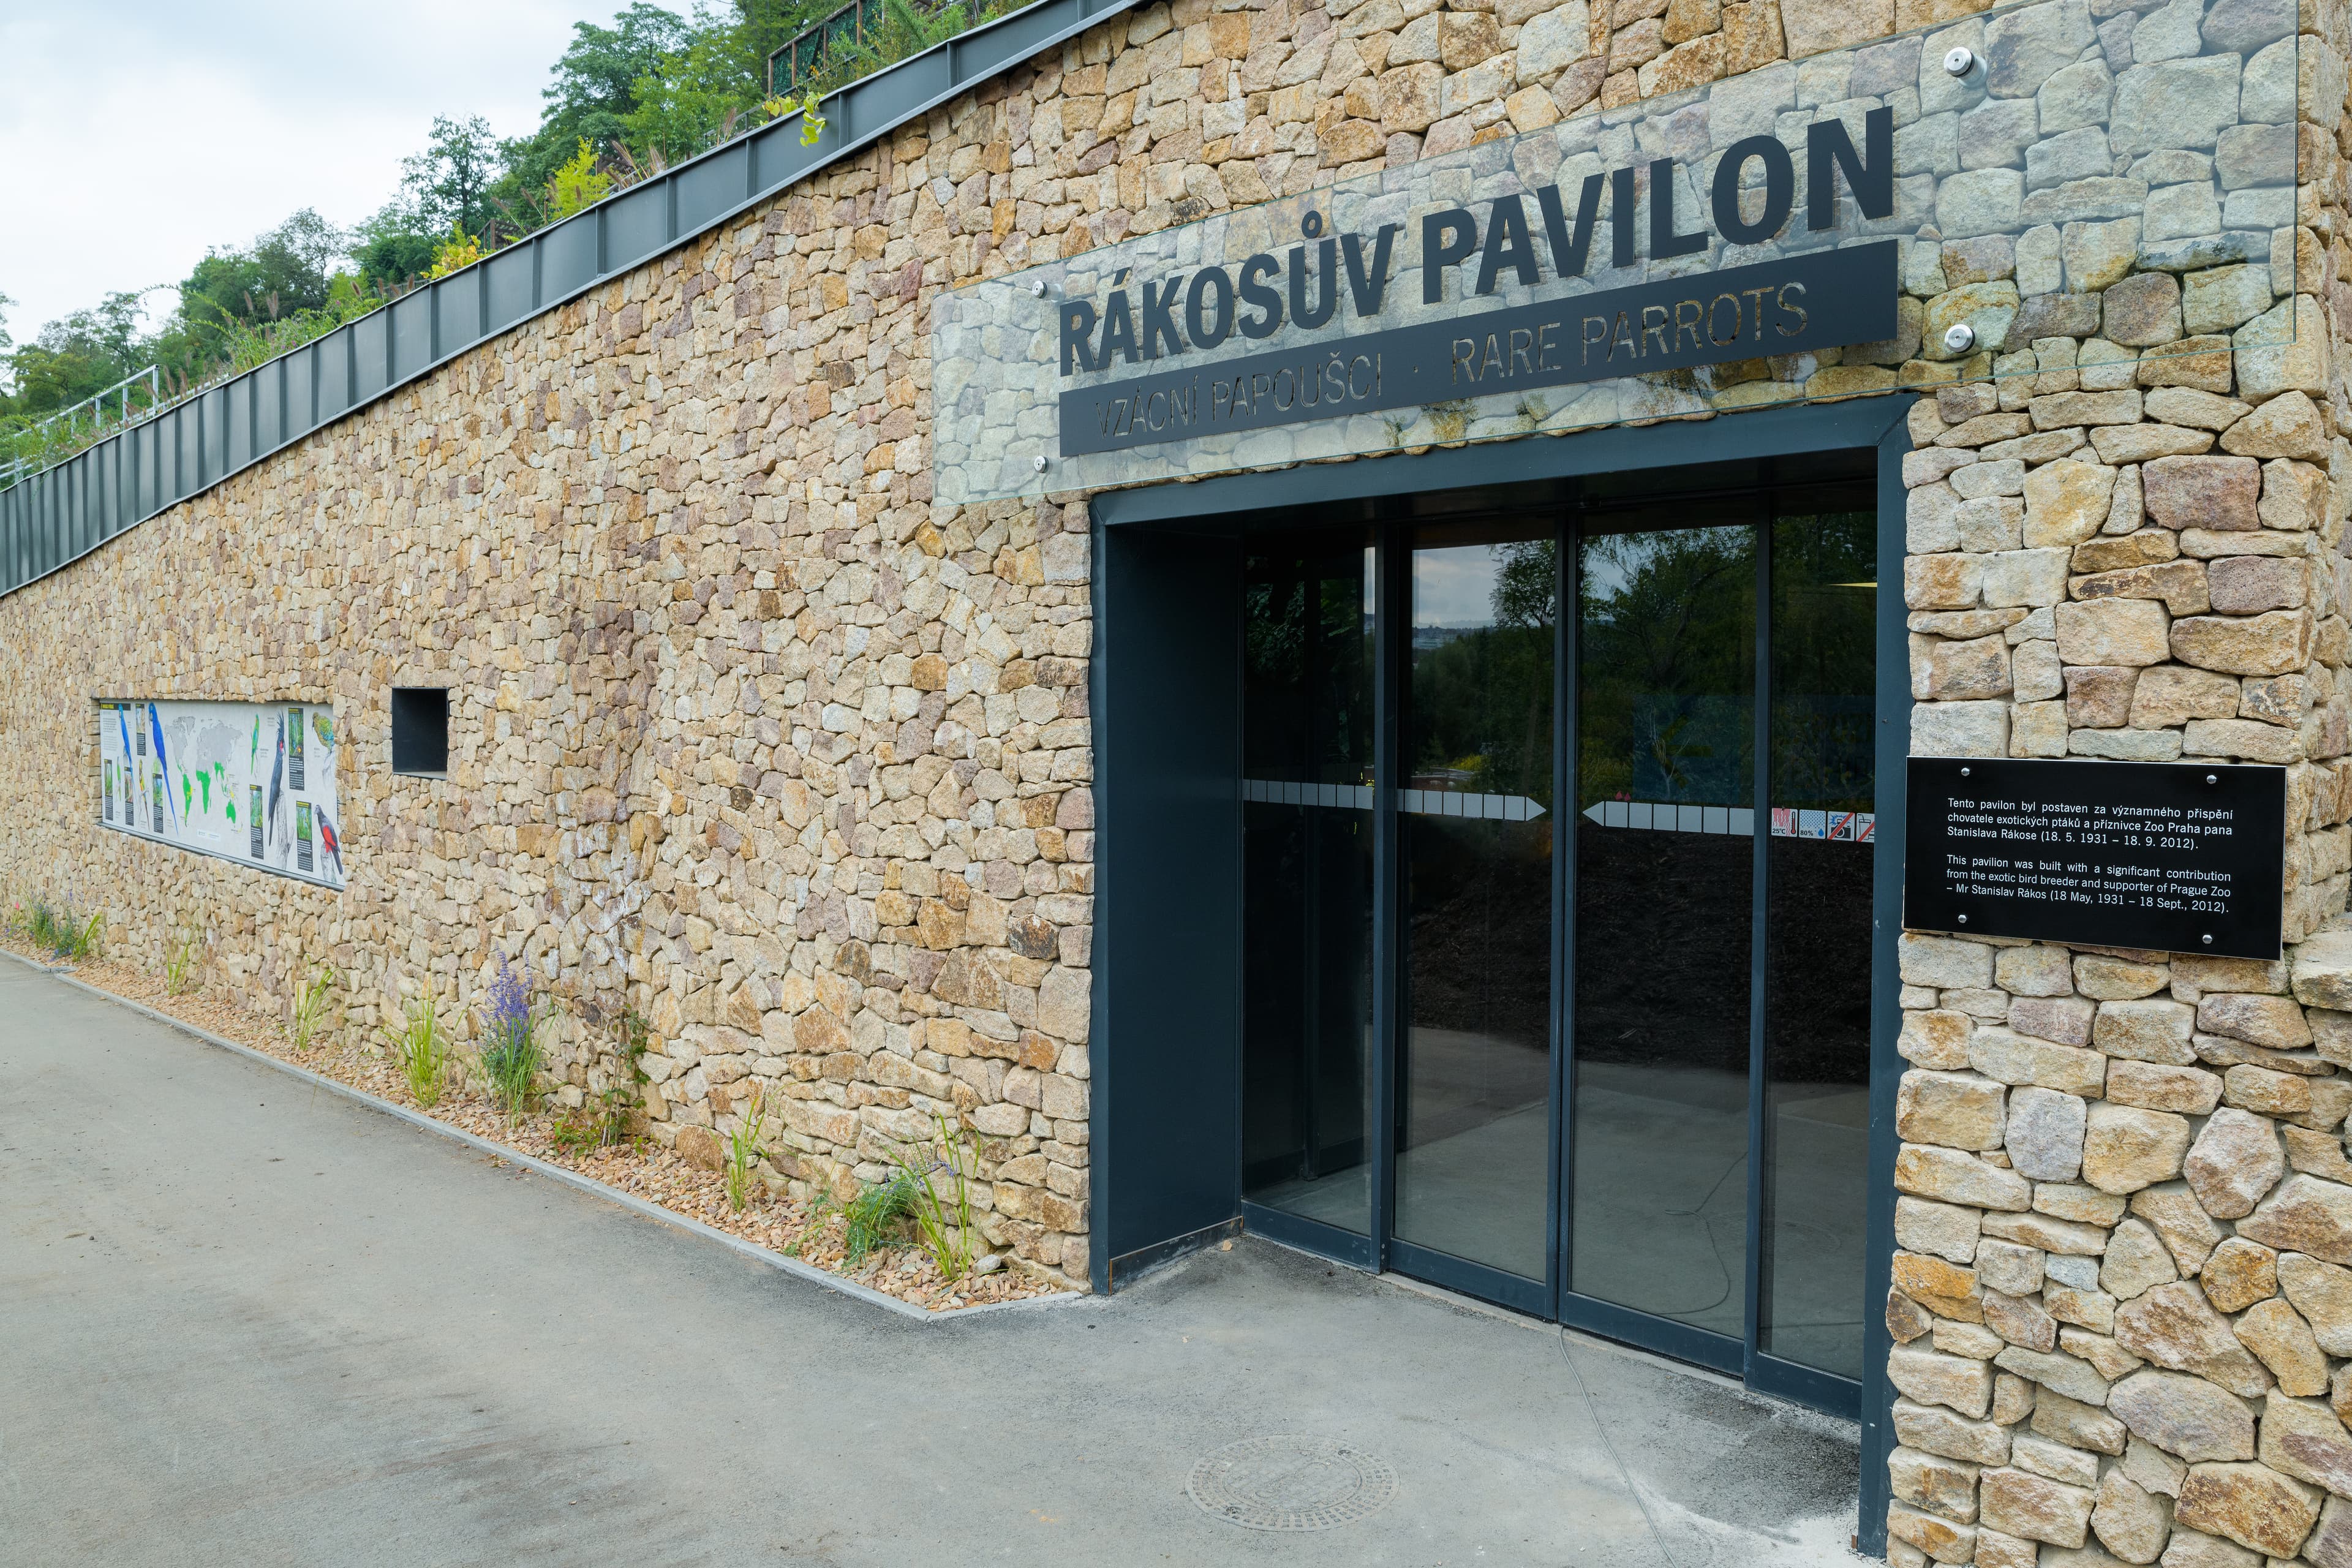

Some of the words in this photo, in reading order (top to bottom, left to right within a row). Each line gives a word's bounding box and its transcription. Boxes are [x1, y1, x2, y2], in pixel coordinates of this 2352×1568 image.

[1060, 210, 1397, 377] RÁKOSŮV
[1423, 105, 1893, 304] PAVILON
[1095, 374, 1198, 439] VZÁCNÍ
[1212, 350, 1381, 422] PAPOUŠCI
[1451, 322, 1561, 385] RARE
[1581, 282, 1807, 368] PARROTS
[1948, 797, 1975, 809] Tento
[1980, 800, 2015, 811] pavilon
[2021, 801, 2035, 813] byl
[2041, 802, 2088, 813] postaven
[2112, 805, 2180, 818] významného
[2187, 808, 2233, 821] přispění
[1947, 812, 1994, 824] chovatele
[1996, 815, 2048, 827] exotických
[2052, 817, 2080, 829] ptáků
[2084, 820, 2090, 829] a
[2094, 819, 2141, 831] příznivce
[2144, 821, 2165, 832] Zoo
[2168, 822, 2200, 834] Praha
[2204, 826, 2232, 836] pana
[1947, 826, 1997, 839] Stanislava
[2001, 829, 2037, 840] Rákose
[2041, 831, 2061, 843] (18.
[2065, 832, 2075, 842] 5.
[2081, 832, 2107, 844] 1931
[2124, 835, 2141, 846] 18.
[2146, 836, 2155, 846] 9.
[2160, 837, 2198, 851] 2012).
[1947, 854, 1967, 865] This
[1972, 857, 2008, 868] pavilion
[2014, 861, 2034, 869] was
[2039, 860, 2062, 871] built
[2067, 862, 2087, 873] with
[2106, 865, 2160, 878] significant
[2166, 869, 2231, 882] contribution
[1946, 868, 1968, 879] from
[1970, 870, 1986, 880] the
[1988, 872, 2016, 883] exotic
[2019, 873, 2037, 884] bird
[2040, 875, 2079, 887] breeder
[2081, 878, 2100, 888] and
[2103, 881, 2154, 892] supporter
[2157, 883, 2168, 893] of
[2170, 883, 2207, 897] Prague
[2211, 886, 2231, 897] Zoo
[1956, 883, 1969, 893] Mr
[1971, 884, 2015, 897] Stanislav
[2018, 888, 2046, 899] Rákos
[2050, 890, 2067, 902] (18
[2070, 891, 2093, 904] May,
[2098, 893, 2124, 905] 1931
[2140, 896, 2154, 907] 18
[2157, 897, 2187, 911] Sept.,
[2192, 900, 2229, 914] 2012).
